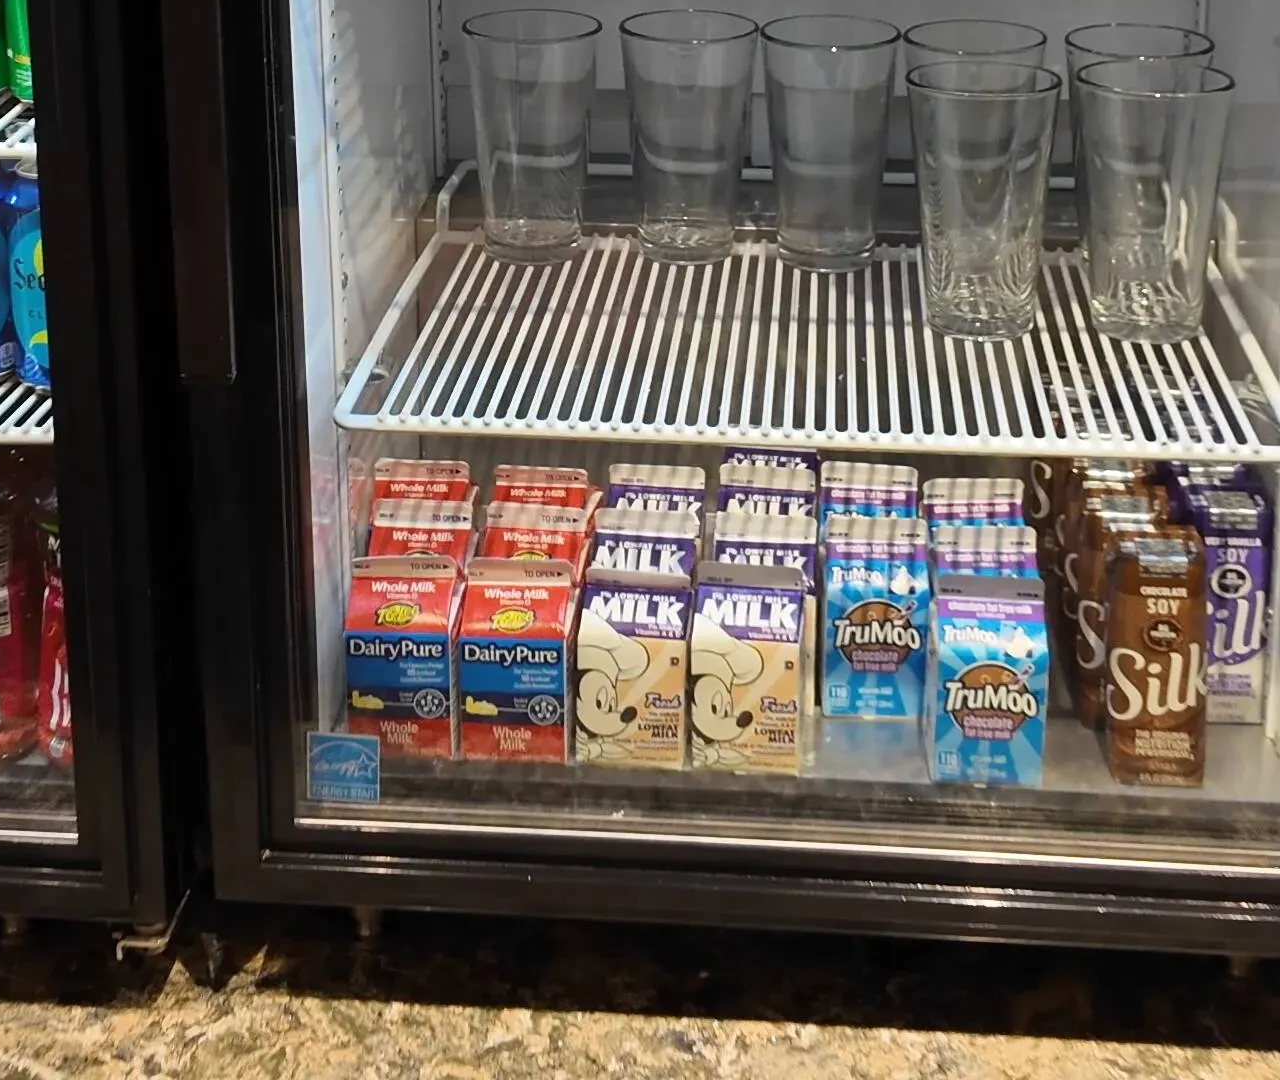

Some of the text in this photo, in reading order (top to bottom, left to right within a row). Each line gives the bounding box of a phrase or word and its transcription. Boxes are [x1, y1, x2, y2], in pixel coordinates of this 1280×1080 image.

[390, 483, 449, 493] Whole Milk
[510, 488, 567, 498] Whole Milk
[393, 531, 455, 542] Whole Milk
[503, 532, 565, 544] Whole Milk
[591, 545, 686, 576] MILK
[1217, 548, 1249, 563] SOY
[535, 570, 555, 578] OPEN
[371, 581, 437, 593] Whole Milk
[484, 588, 549, 600] Whole Milk
[589, 595, 685, 629] MILK
[1146, 598, 1181, 614] SOY
[701, 598, 798, 630] MILK
[349, 638, 443, 661] DairyPure
[464, 644, 558, 667] DairyPure
[1106, 642, 1208, 721] Silk
[380, 720, 419, 734] Whole
[963, 714, 1014, 730] chocolate
[387, 732, 413, 744] Milk
[492, 725, 533, 740] Whole
[499, 738, 527, 751] Milk
